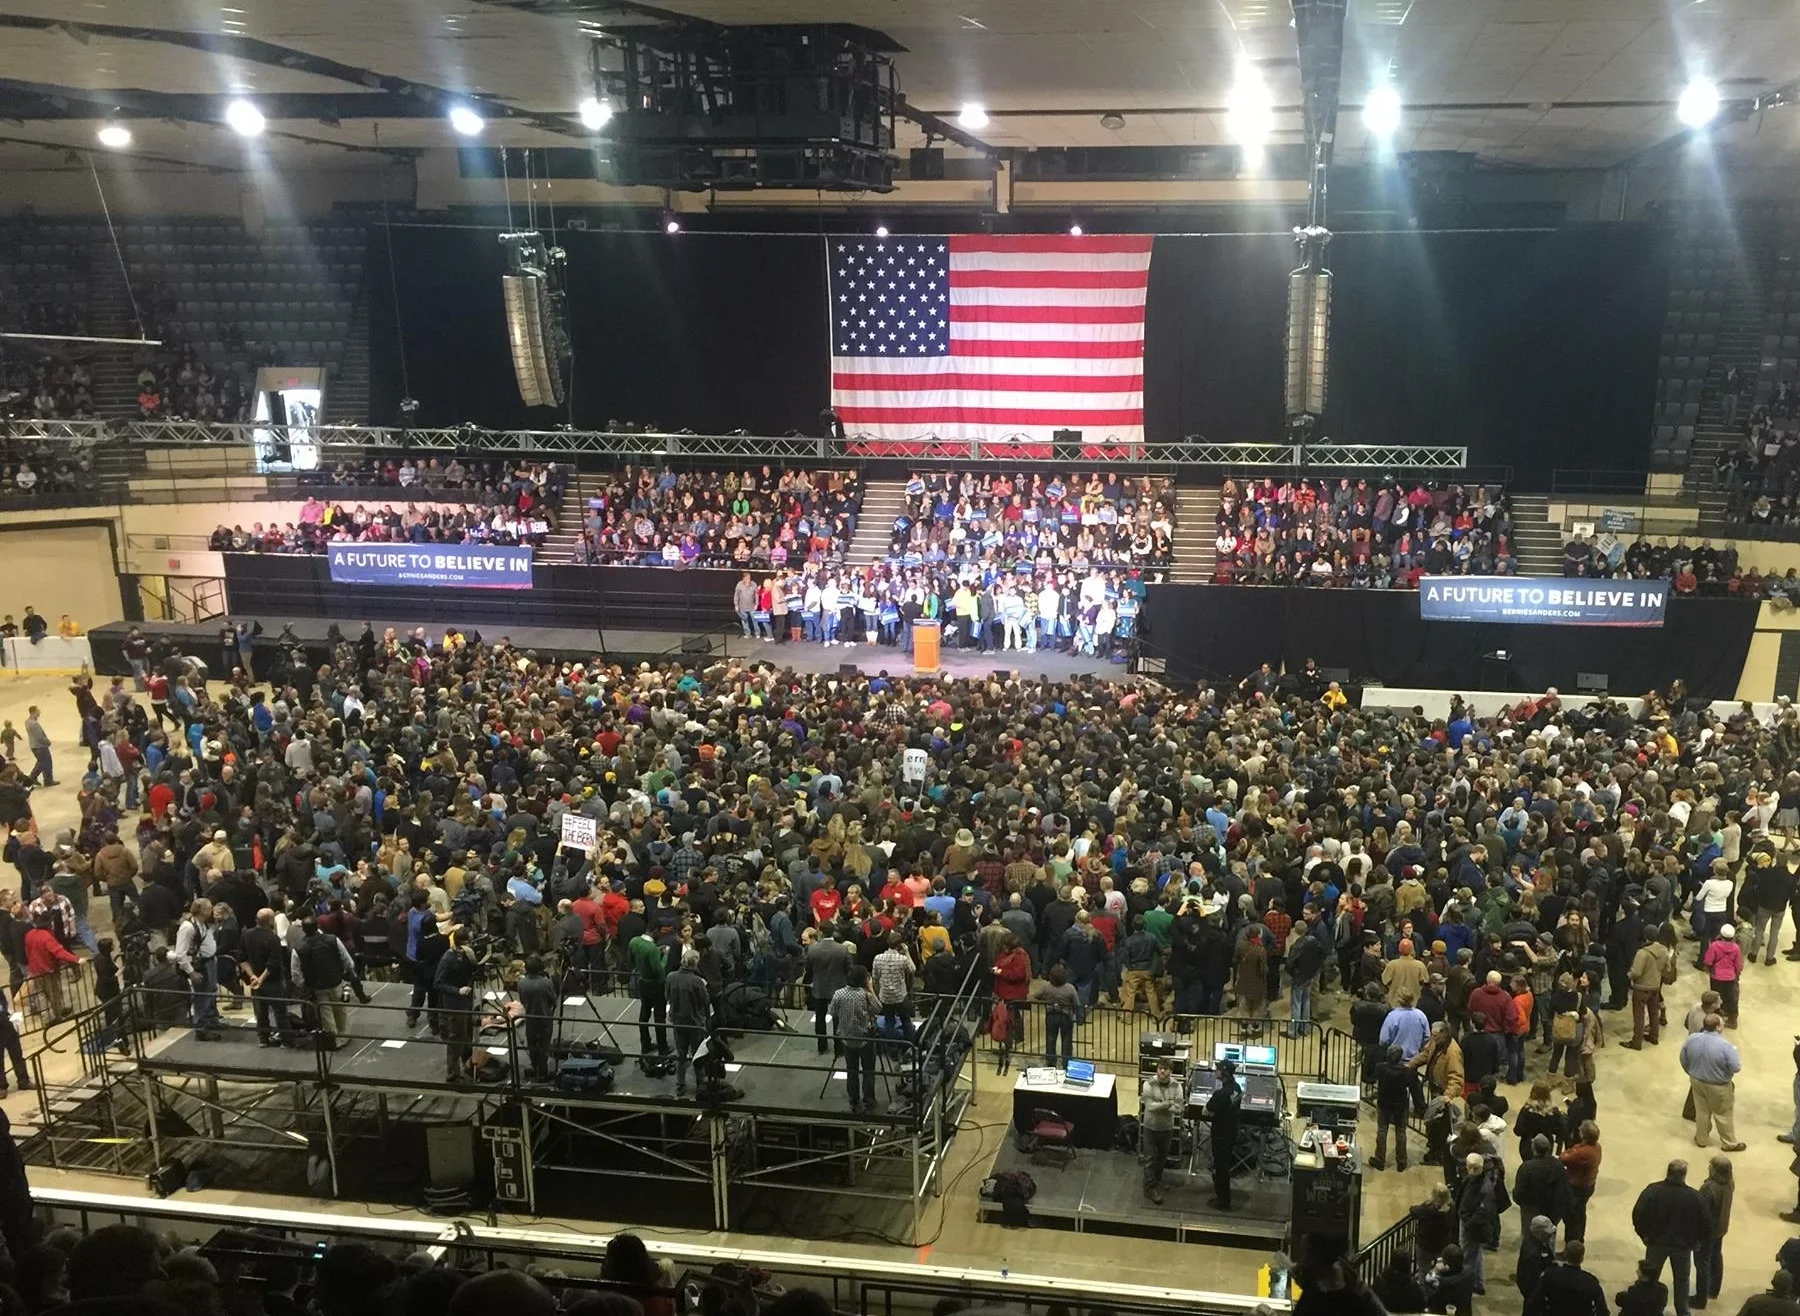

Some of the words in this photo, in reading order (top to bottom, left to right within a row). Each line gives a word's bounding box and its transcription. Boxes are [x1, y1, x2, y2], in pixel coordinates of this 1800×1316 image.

[335, 553, 345, 566] A
[347, 553, 406, 568] FUTURE
[409, 555, 431, 569] TO
[435, 556, 506, 571] BELIEVE
[510, 558, 528, 572] IN
[398, 573, 464, 581] BERNIESANDERS.COM
[1426, 586, 1440, 602] A
[1443, 586, 1514, 603] FUTURE
[1517, 588, 1545, 605] TO
[1548, 589, 1635, 607] BELIEVE
[1640, 592, 1663, 608] IN
[1502, 609, 1581, 618] BERNIESANDERS.COM
[564, 816, 592, 830] #FEEL
[563, 828, 577, 843] THE
